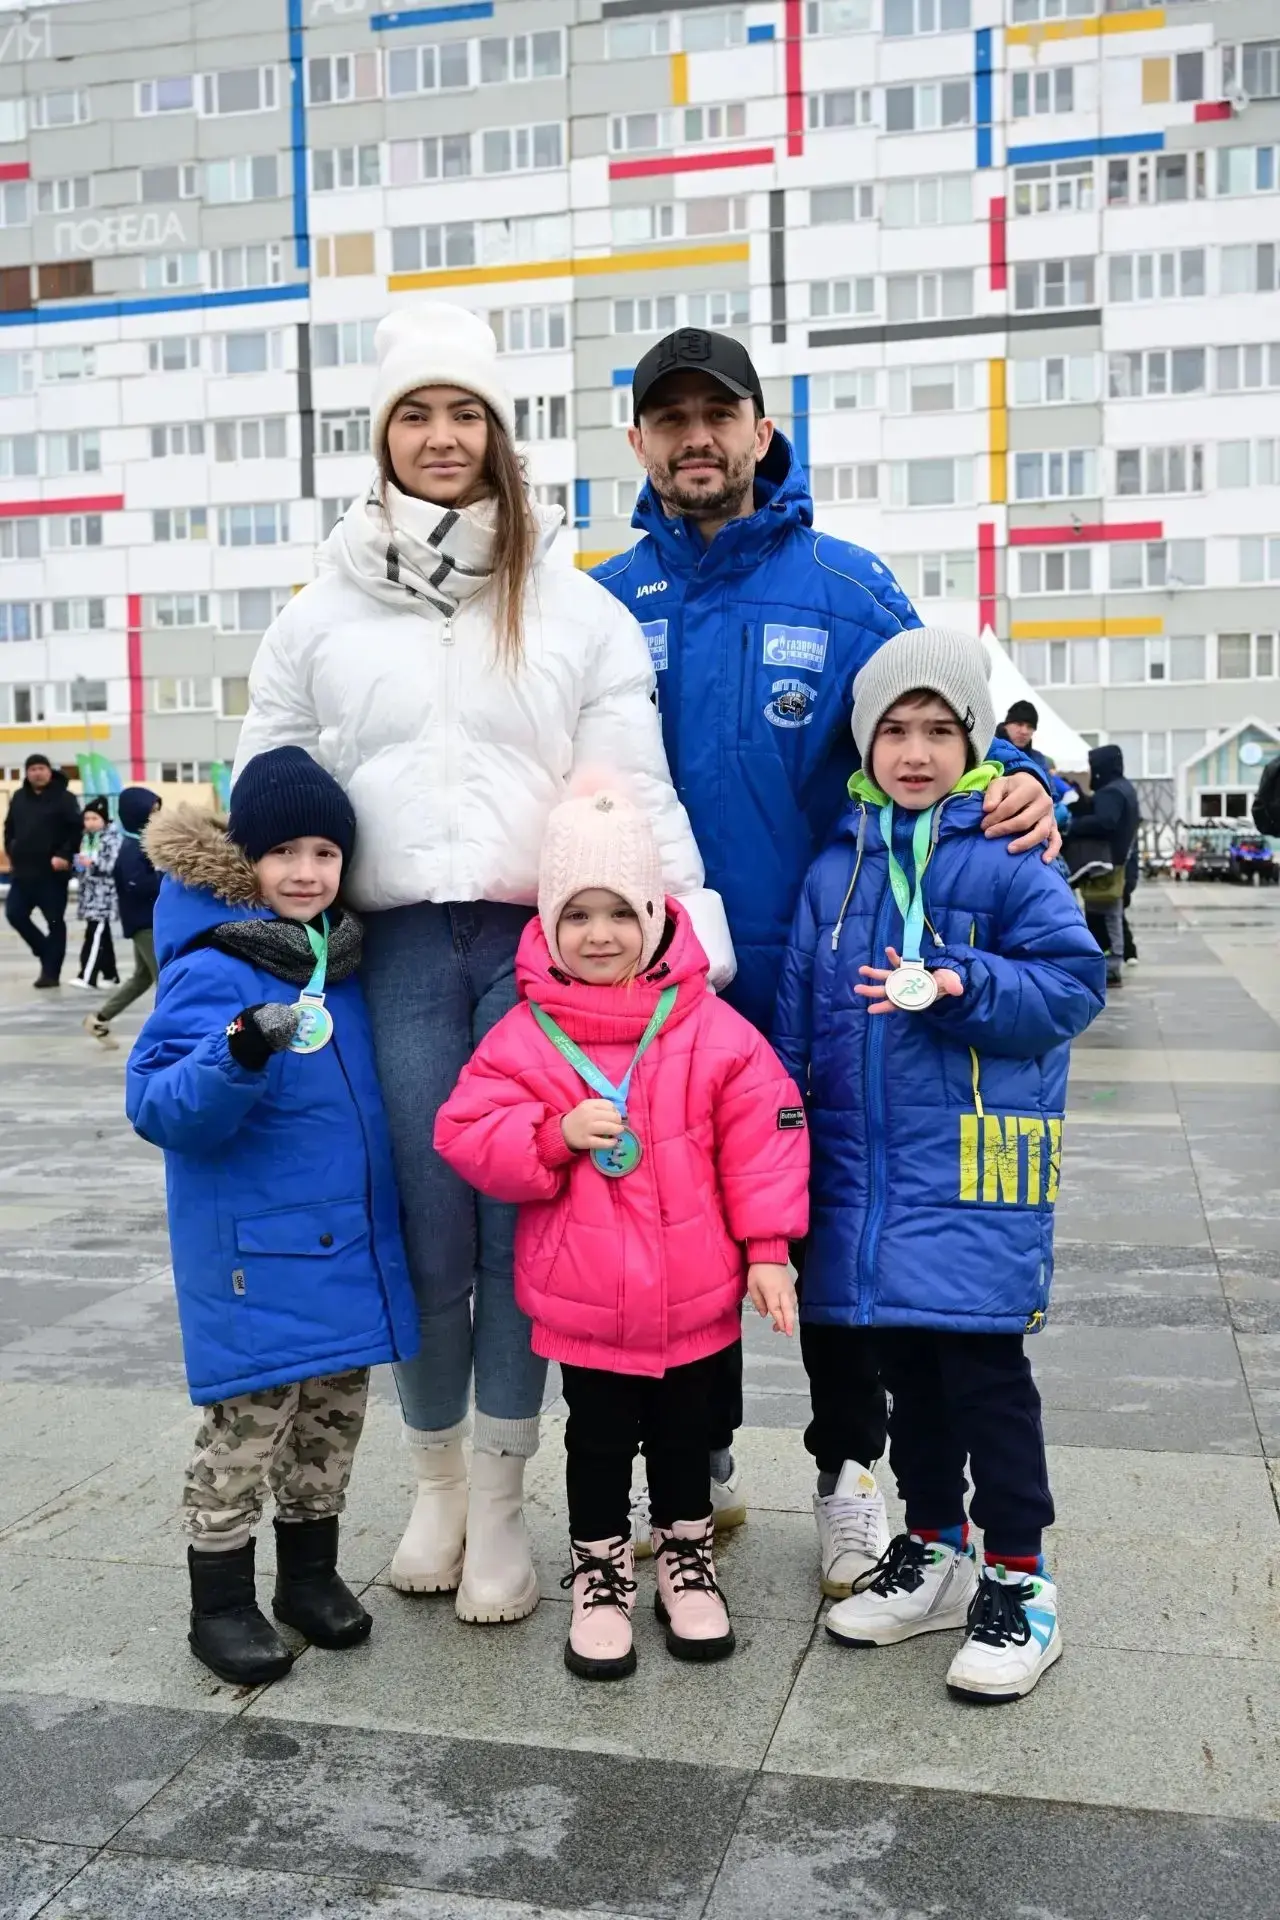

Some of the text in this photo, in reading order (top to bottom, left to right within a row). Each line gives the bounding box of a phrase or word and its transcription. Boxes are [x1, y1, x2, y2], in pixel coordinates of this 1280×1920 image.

[54, 211, 187, 255] ПОБЕДА
[636, 580, 668, 599] JAKO
[786, 639, 824, 656] ГАЗПРОМ
